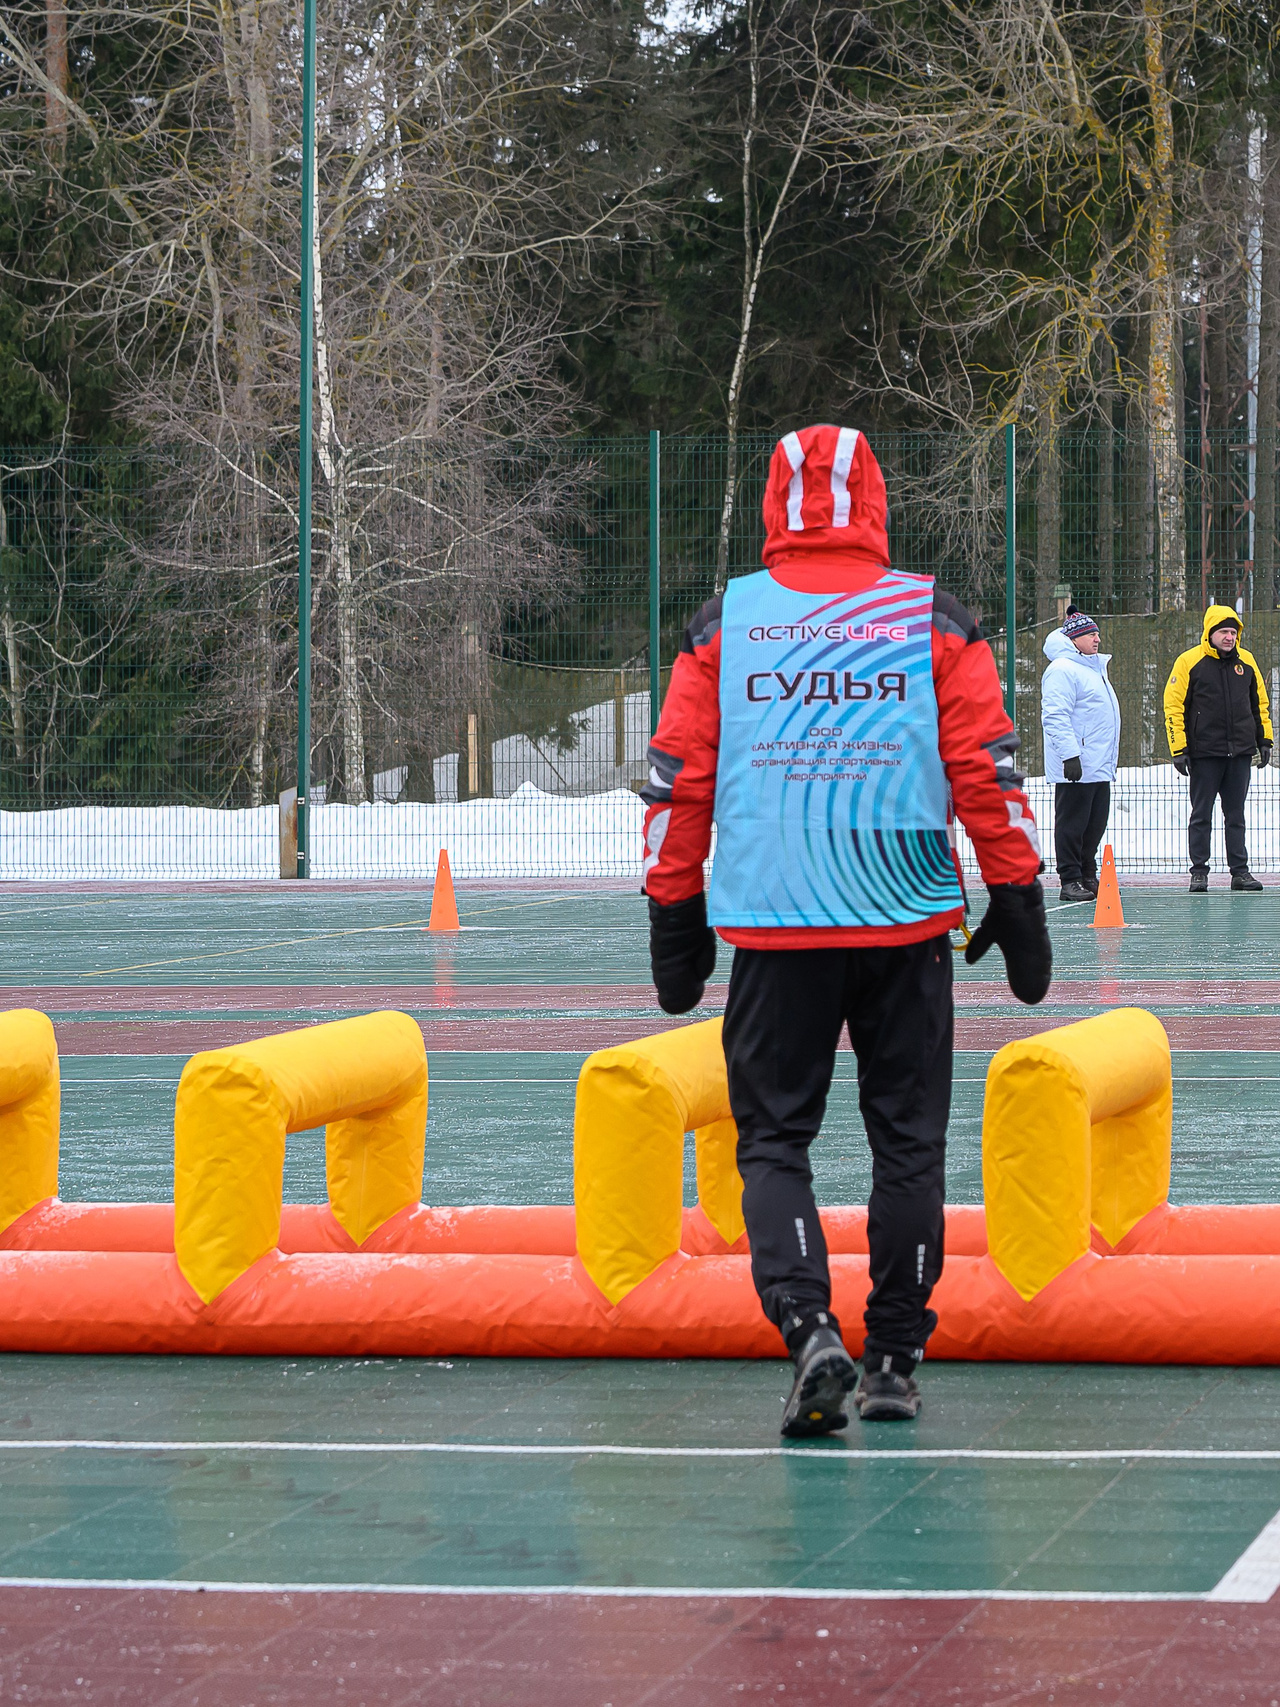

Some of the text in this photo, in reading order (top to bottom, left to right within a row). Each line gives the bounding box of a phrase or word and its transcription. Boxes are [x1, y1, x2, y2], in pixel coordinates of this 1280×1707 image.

[847, 625, 906, 641] LIFE
[746, 671, 907, 705] СУДЬЯ
[809, 727, 843, 737] ООО
[751, 757, 902, 768] организация спортивных
[784, 771, 867, 782] мероприятий
